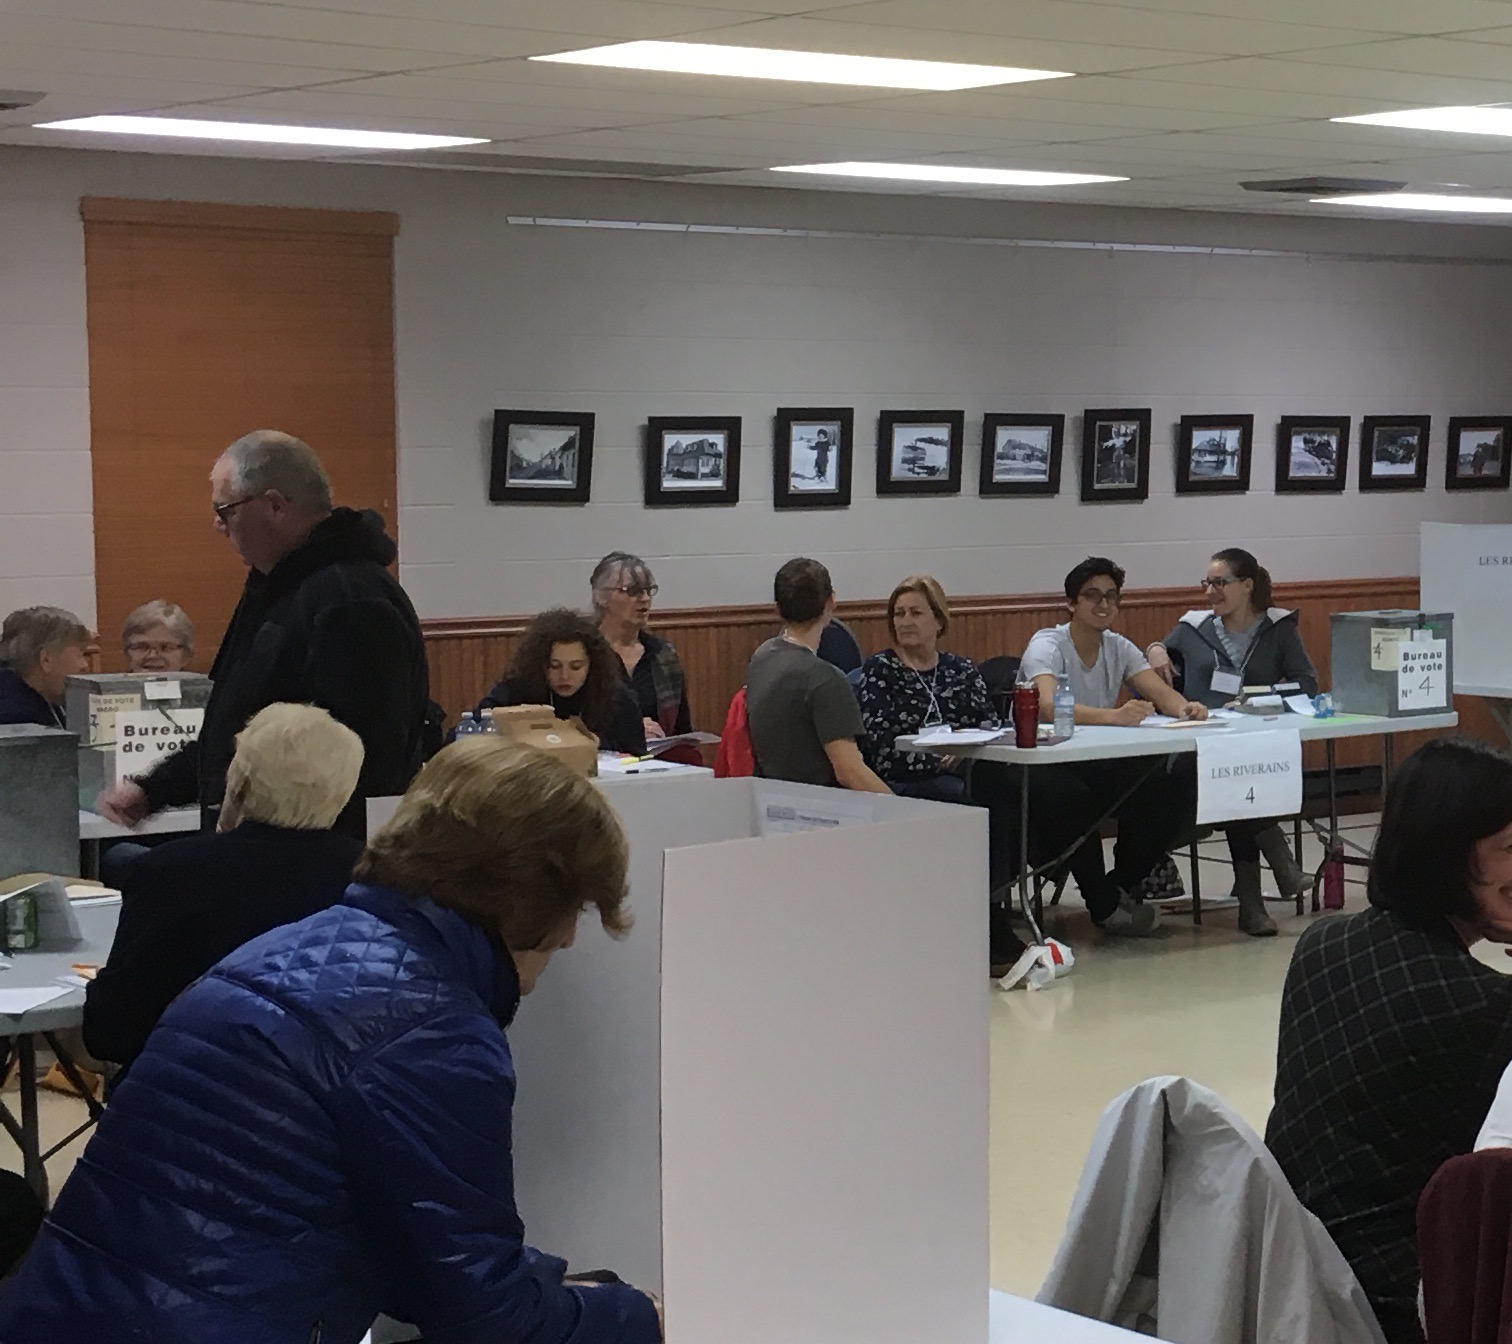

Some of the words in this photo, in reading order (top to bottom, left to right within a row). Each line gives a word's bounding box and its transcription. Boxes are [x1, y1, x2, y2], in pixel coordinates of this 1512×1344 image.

[1479, 556, 1499, 566] LES
[1403, 652, 1442, 662] Bureau
[1402, 663, 1415, 674] de
[1420, 662, 1443, 672] vote
[1418, 675, 1434, 696] 4
[123, 725, 196, 737] Bureau
[122, 741, 145, 753] de
[156, 739, 189, 751] vot
[1211, 767, 1231, 779] LES
[1233, 761, 1290, 776] RIVERAINS
[1245, 786, 1255, 804] 4
